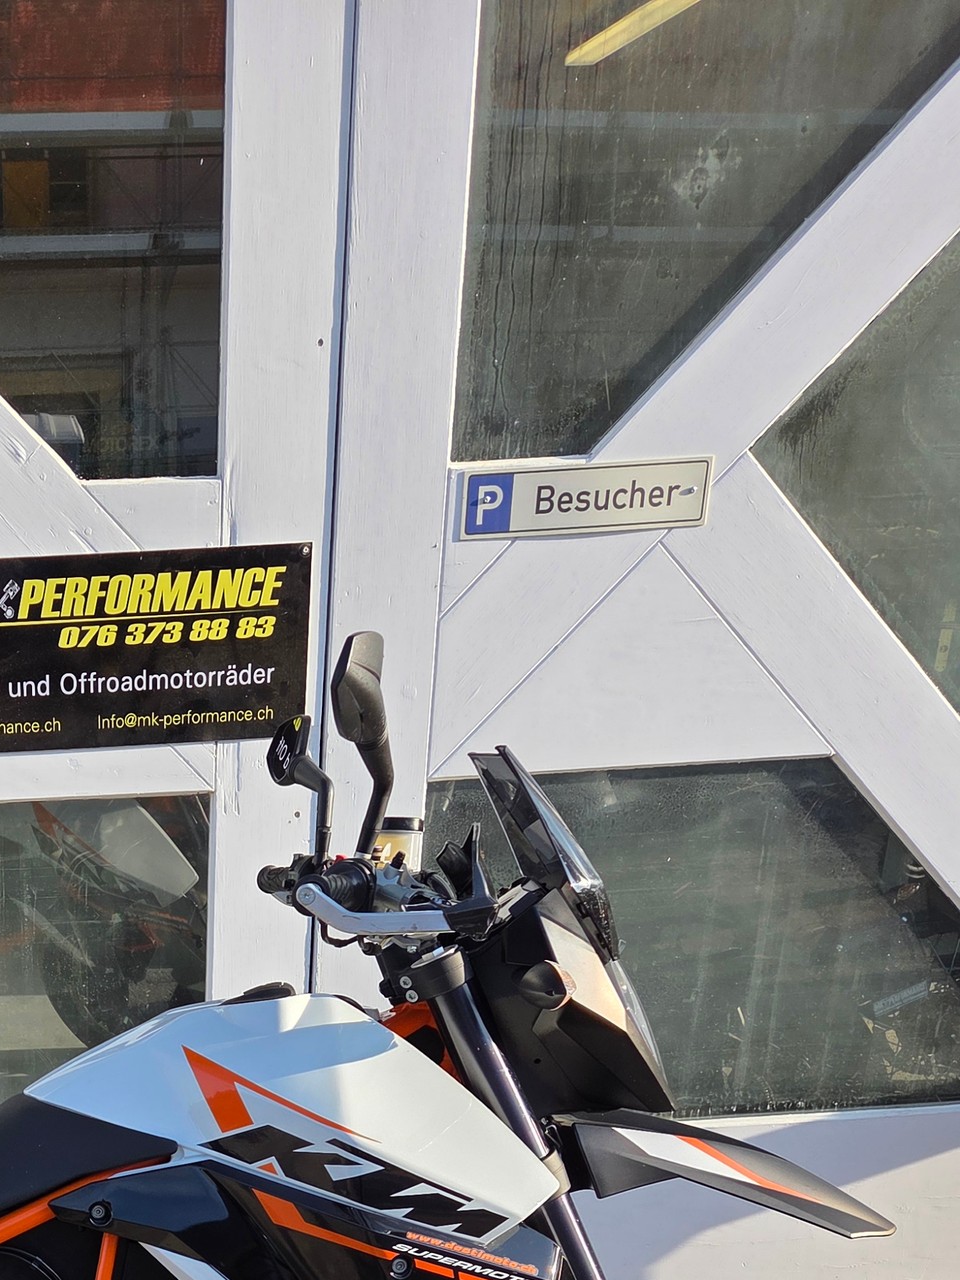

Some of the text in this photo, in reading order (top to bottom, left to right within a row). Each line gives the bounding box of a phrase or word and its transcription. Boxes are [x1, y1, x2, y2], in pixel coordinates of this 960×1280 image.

[475, 480, 681, 525] P Besucher
[17, 566, 287, 620] PERFORMANCE
[58, 616, 276, 649] 076 373 88 83
[8, 674, 50, 699] und
[60, 664, 276, 696] Offroadmotorräder
[97, 706, 275, 731] Info@mk-performance.ch
[197, 1124, 511, 1241] KTM
